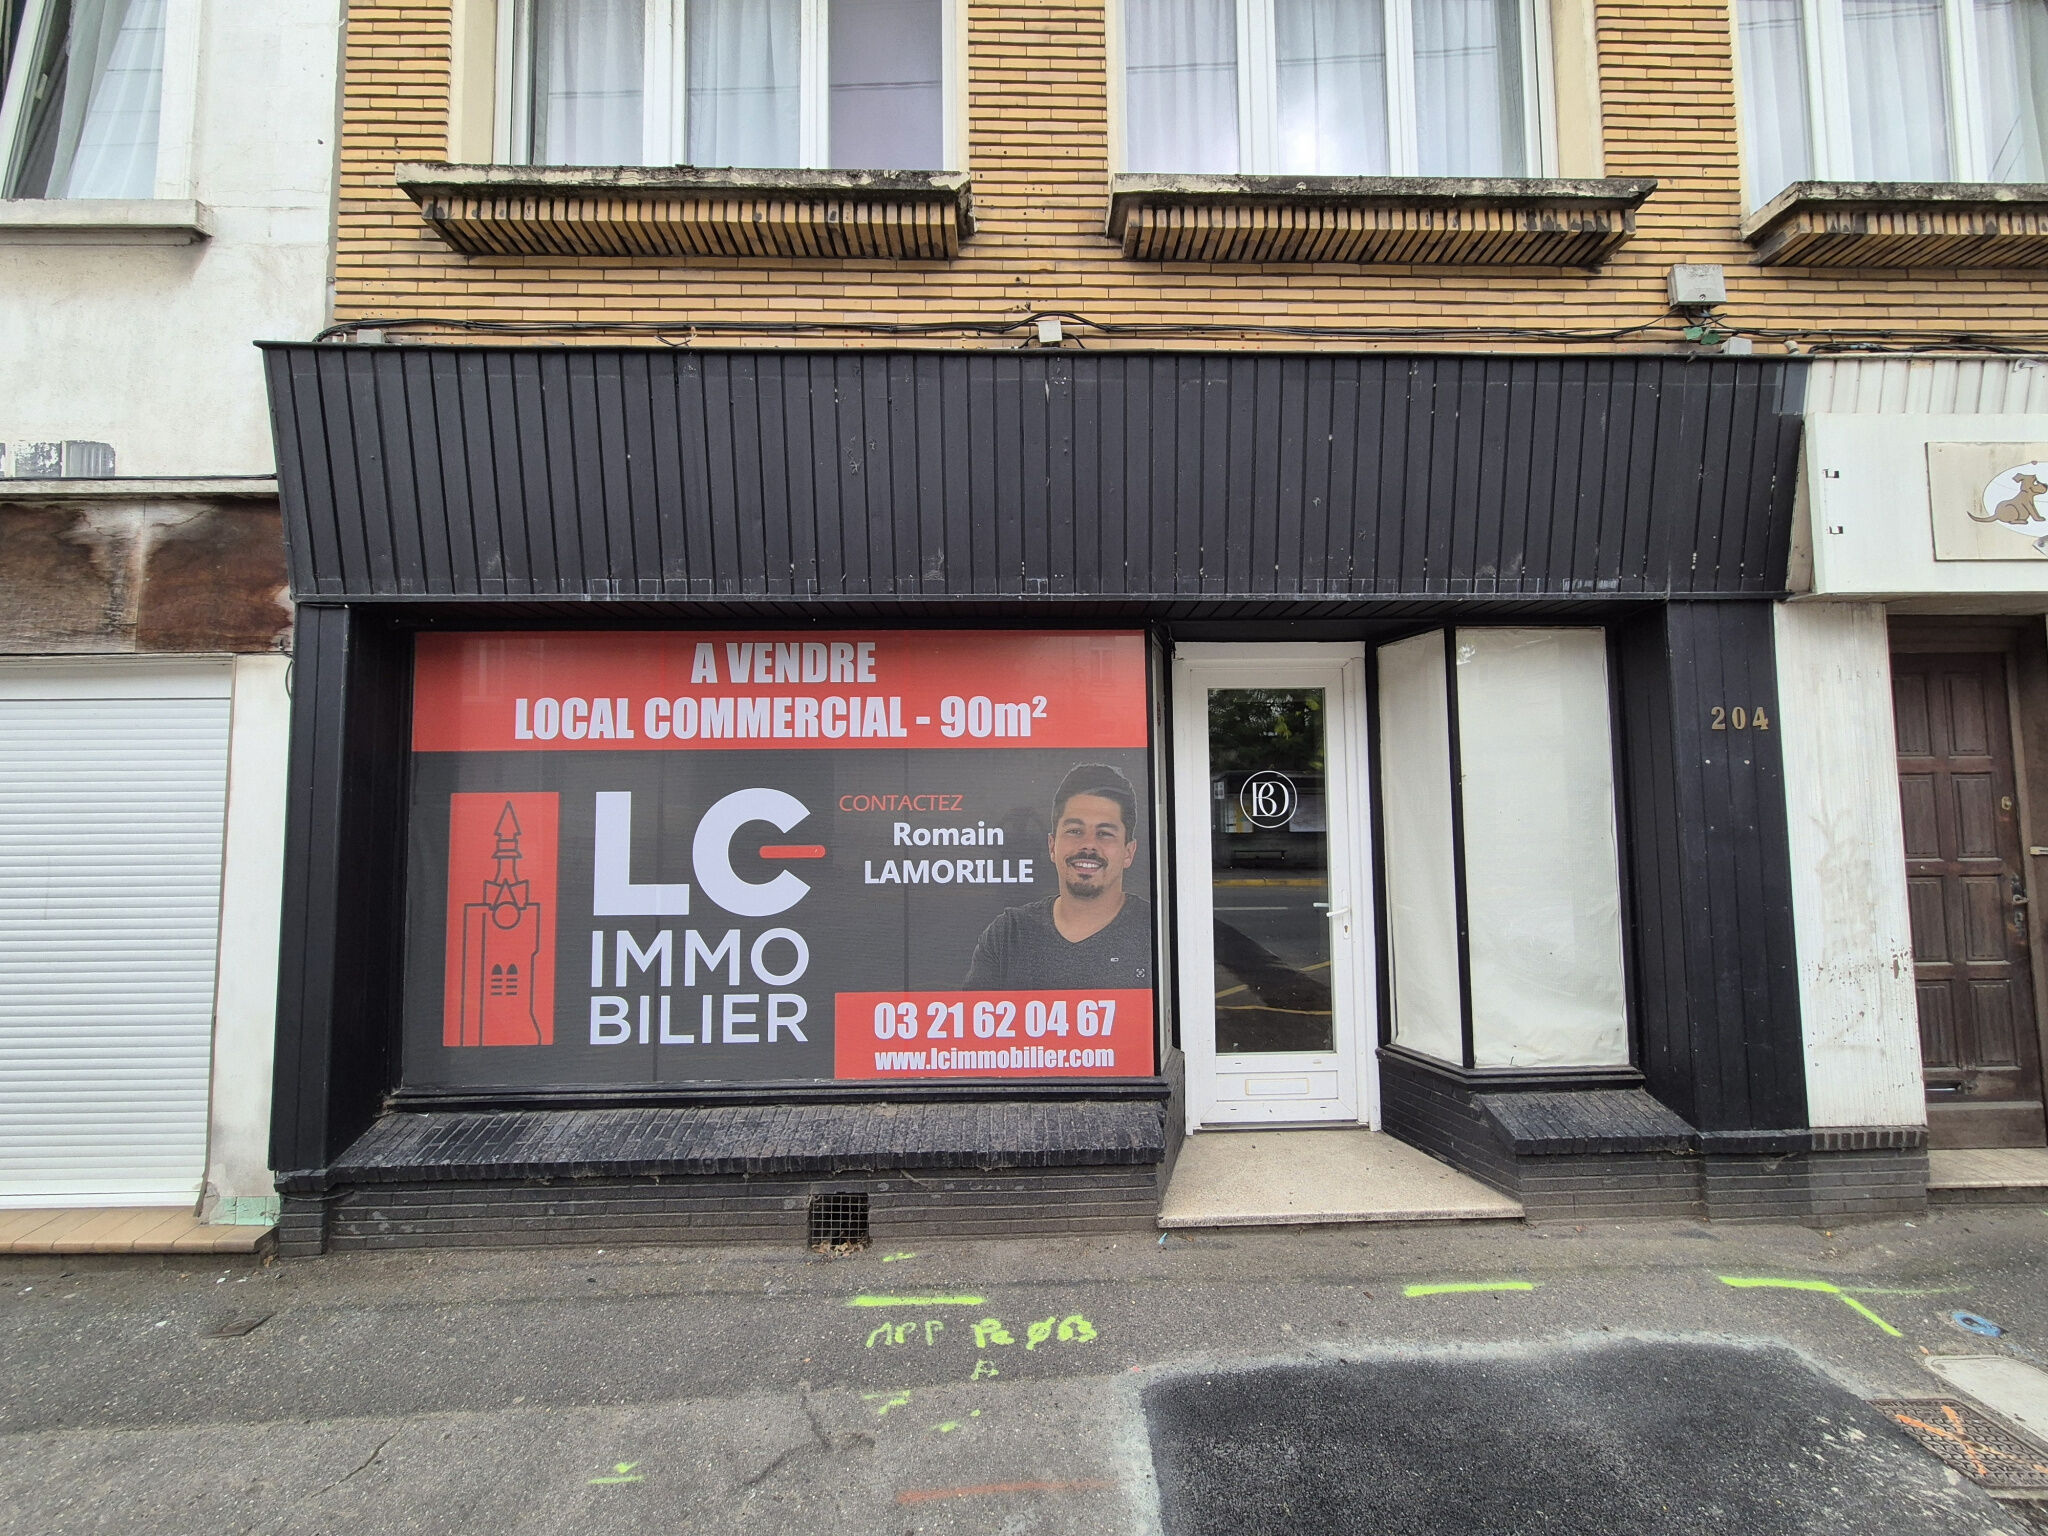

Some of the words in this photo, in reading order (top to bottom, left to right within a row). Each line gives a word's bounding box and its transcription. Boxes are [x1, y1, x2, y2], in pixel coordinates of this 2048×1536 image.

[690, 642, 719, 684] A
[726, 641, 877, 684] VENDRE
[514, 697, 635, 740] LOCAL
[644, 696, 908, 740] COMMERCIAL
[1711, 706, 1769, 730] 204
[839, 794, 964, 812] CONTACTEZ
[593, 787, 812, 917] LC
[893, 821, 1004, 846] Romain
[864, 859, 1034, 884] LAMORILLE
[591, 927, 810, 988] IMMO
[589, 993, 809, 1045] BILIER
[874, 1001, 918, 1040] 03
[926, 1001, 964, 1038] 21
[973, 1000, 1016, 1038] 62
[1024, 1000, 1069, 1037] 04
[1076, 999, 1116, 1037] 67
[874, 1046, 1115, 1071] www.lcimmobilier.com
